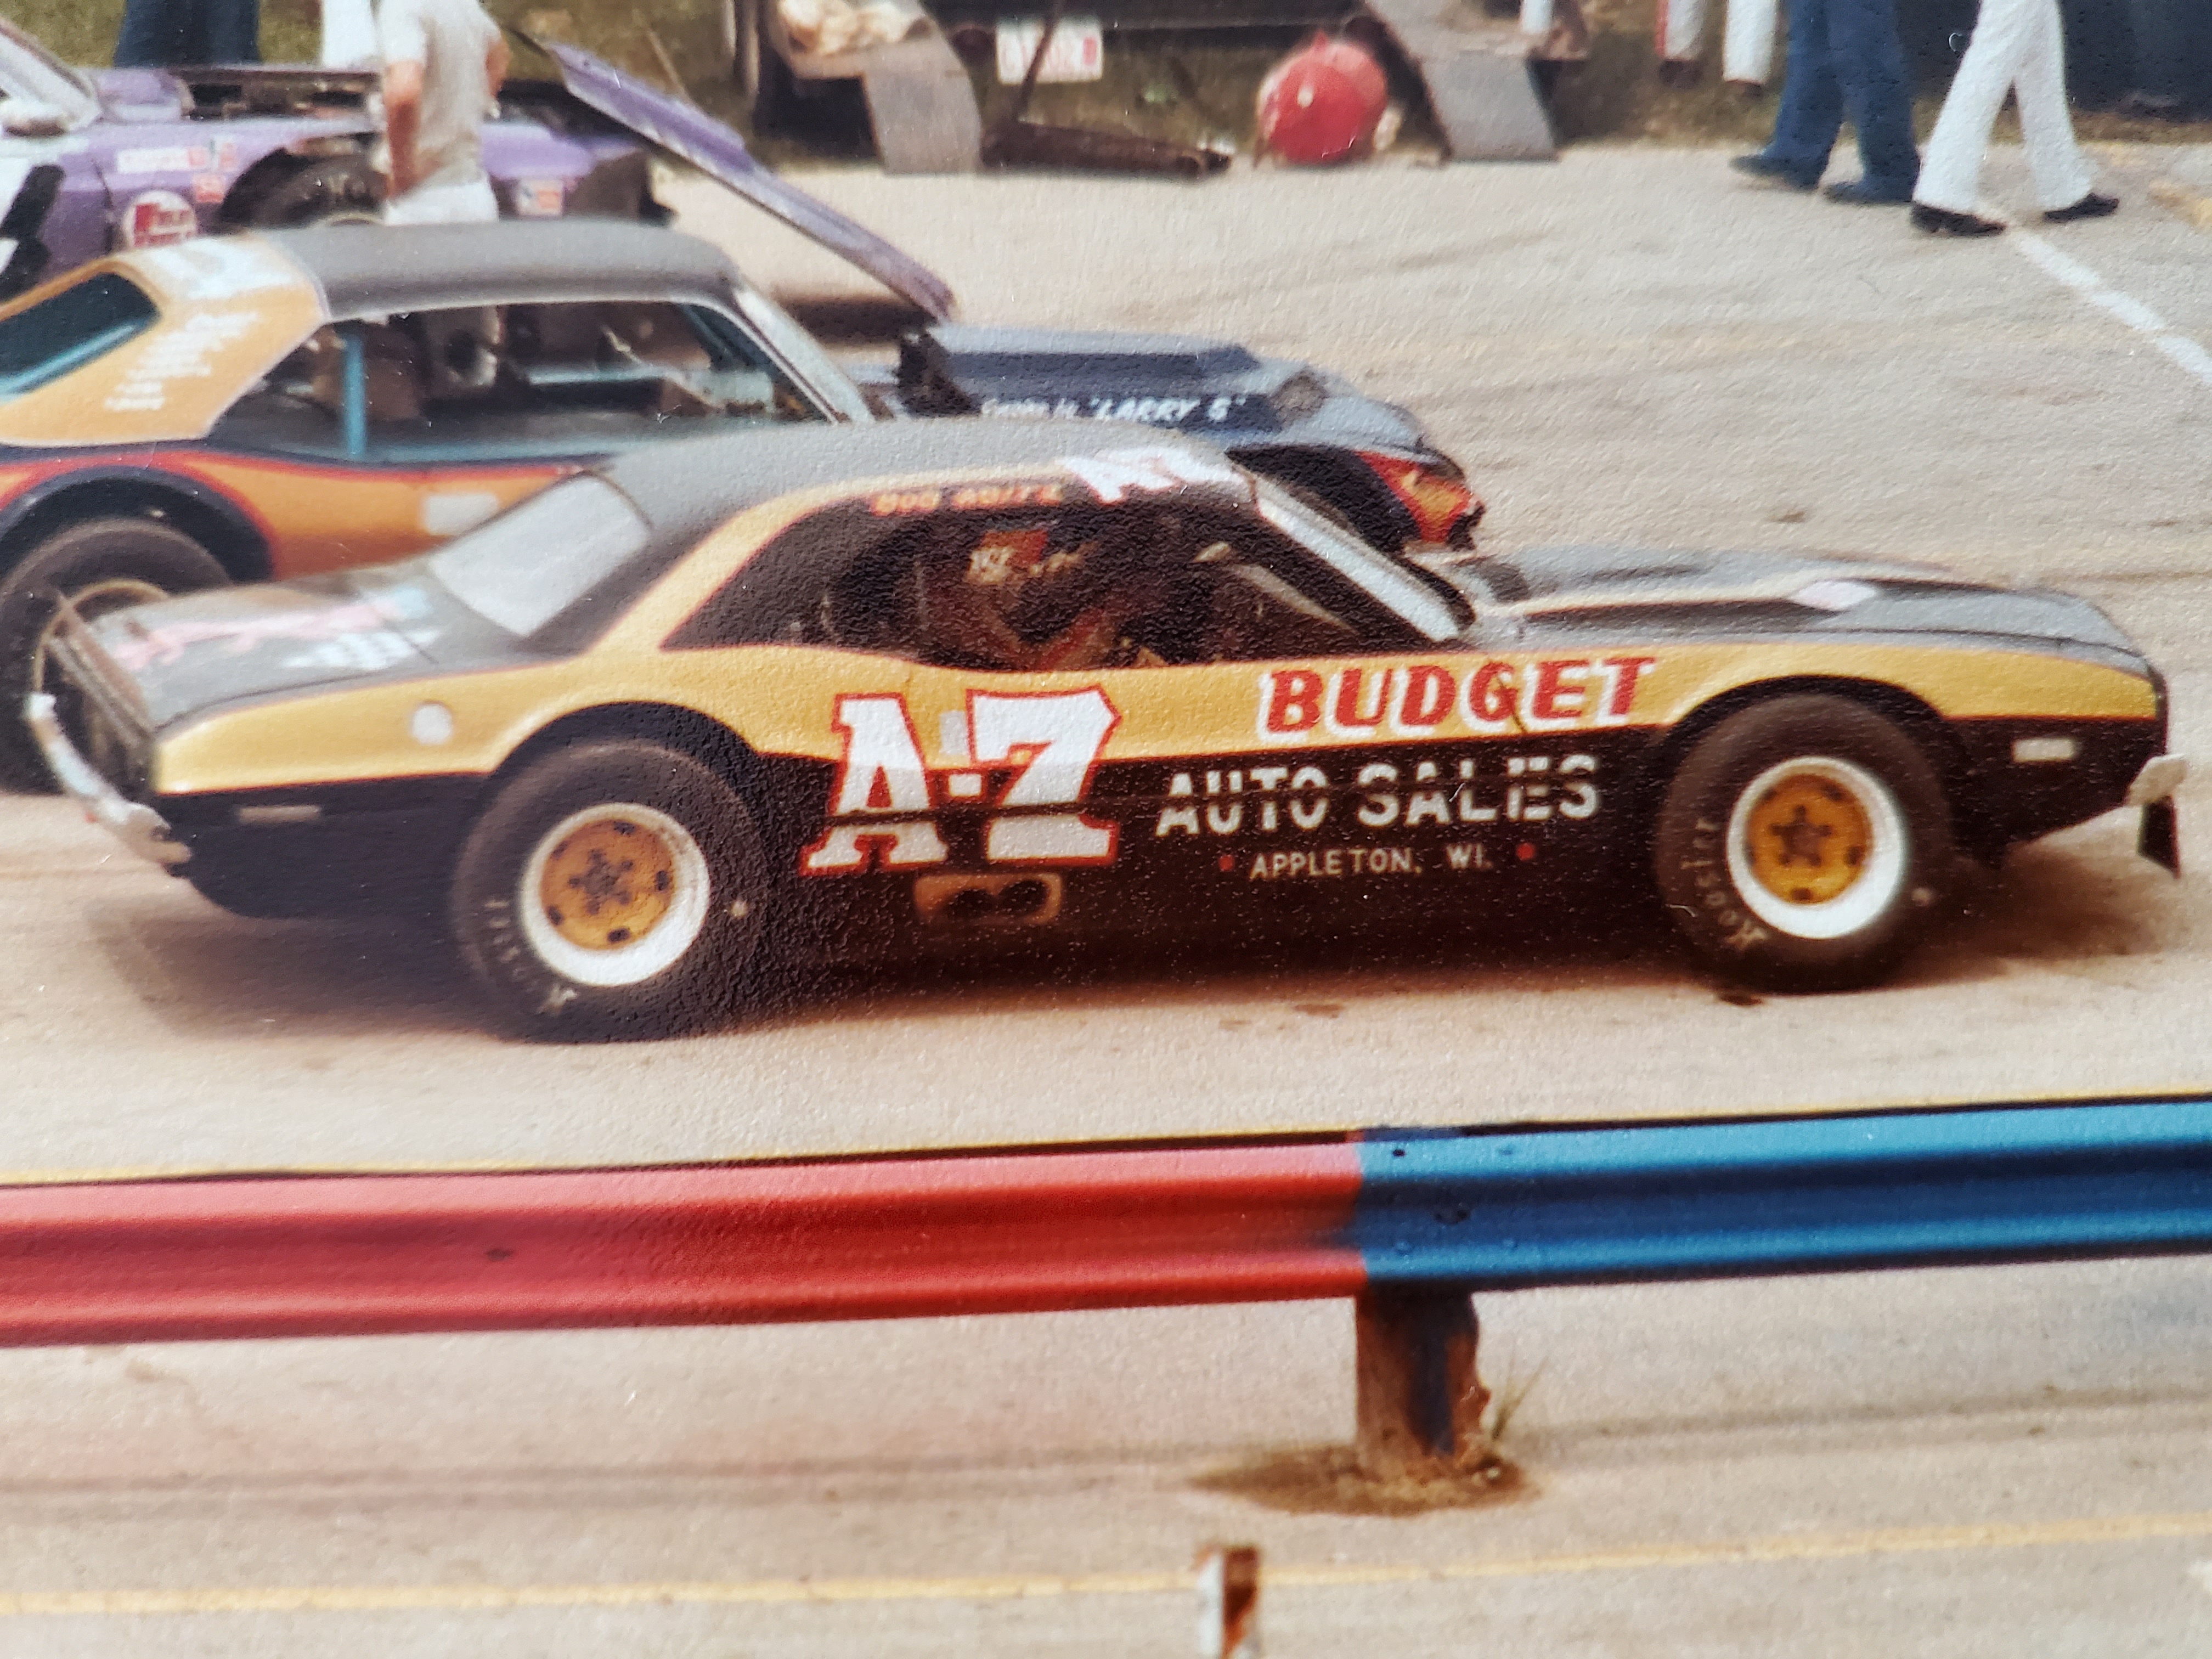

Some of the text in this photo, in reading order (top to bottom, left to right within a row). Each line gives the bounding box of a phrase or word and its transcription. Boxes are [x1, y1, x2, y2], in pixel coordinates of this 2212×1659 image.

[1258, 658, 1656, 743] BUDGET
[1155, 754, 1599, 837] AUTO SALES
